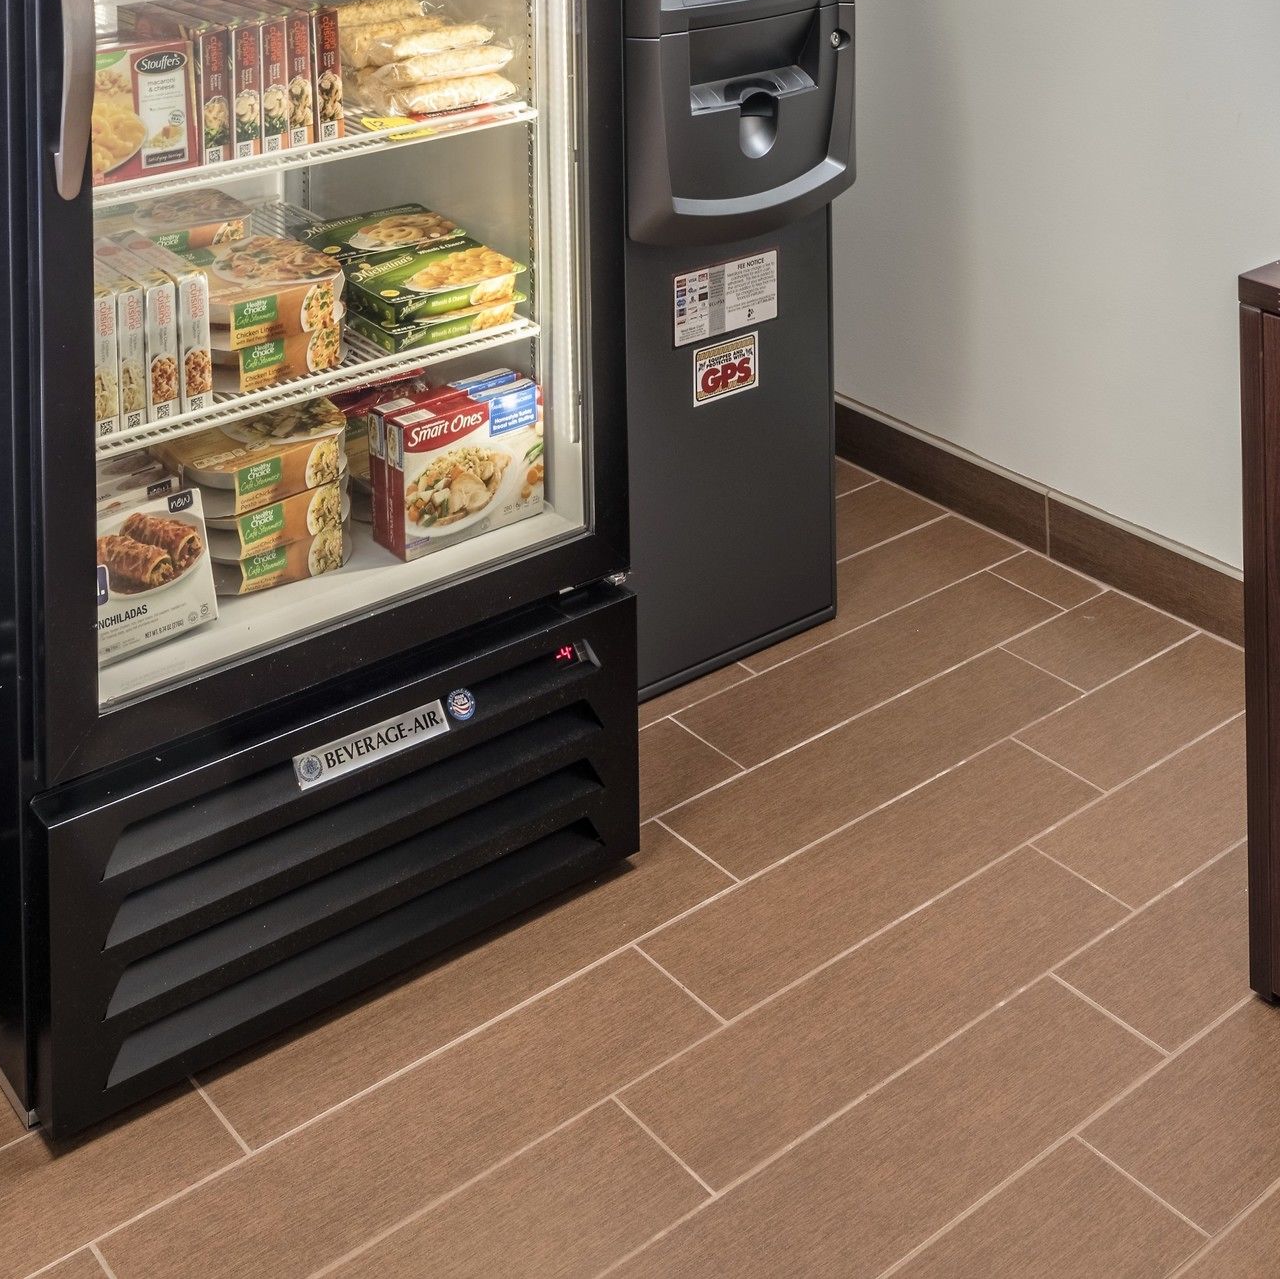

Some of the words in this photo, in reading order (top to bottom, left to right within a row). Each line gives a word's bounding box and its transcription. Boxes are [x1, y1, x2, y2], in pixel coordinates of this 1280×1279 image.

[140, 53, 181, 72] Stouffer's
[154, 84, 176, 93] cheese
[356, 255, 413, 281] Michelina's
[737, 262, 746, 270] FEE
[746, 257, 765, 269] NOTICE
[156, 289, 164, 326] cuisine
[244, 304, 268, 316] Choice
[246, 299, 268, 310] Healthy
[99, 300, 108, 337] cuisine
[236, 328, 258, 340] Chicken
[251, 347, 275, 359] Choice
[254, 341, 275, 352] Healthy
[706, 358, 733, 369] PROTECTED
[733, 353, 746, 362] WITH
[708, 352, 732, 364] EQUIPPED
[732, 349, 744, 358] AND
[701, 357, 751, 395] GPS
[407, 421, 449, 448] Smart
[451, 411, 484, 433] Ones
[247, 468, 271, 481] Choice
[250, 462, 272, 474] Healthy
[171, 494, 191, 510] new
[250, 515, 274, 529] Choice
[253, 552, 277, 565] Choice
[324, 709, 441, 770] BEVERAGE-AIR
